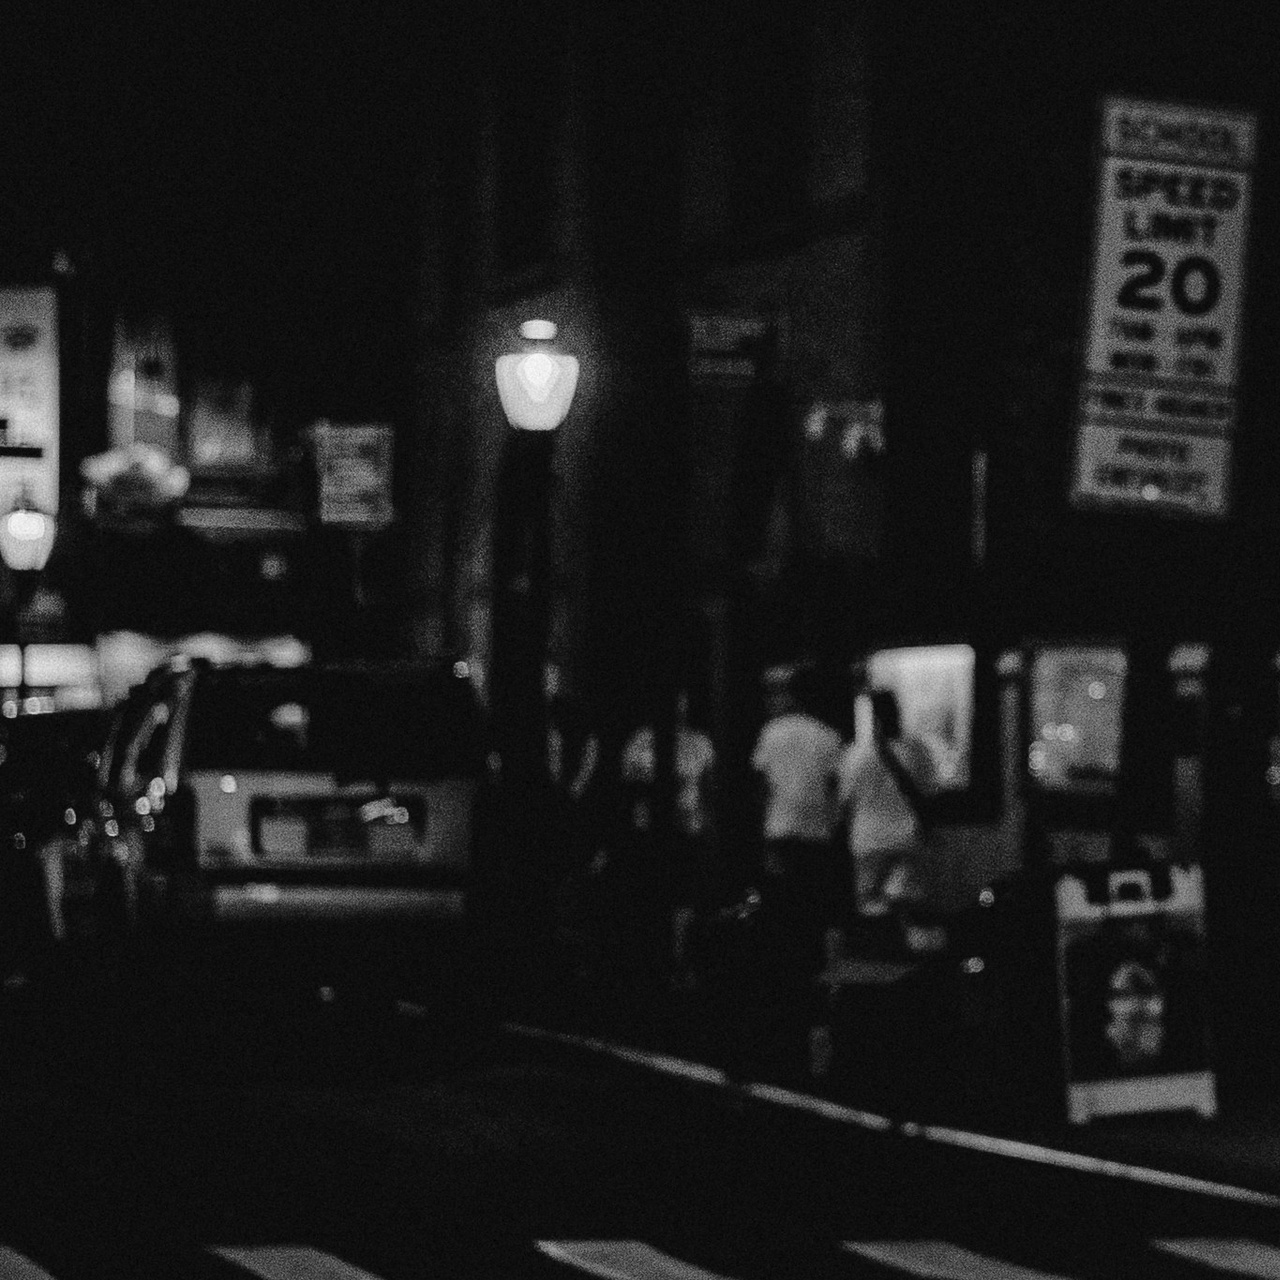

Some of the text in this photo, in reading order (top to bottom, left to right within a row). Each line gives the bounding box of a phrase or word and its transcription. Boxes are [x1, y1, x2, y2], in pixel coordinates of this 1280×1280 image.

[1116, 168, 1240, 210] SPEED
[1123, 210, 1216, 245] LIMIT
[1117, 250, 1221, 317] 20
